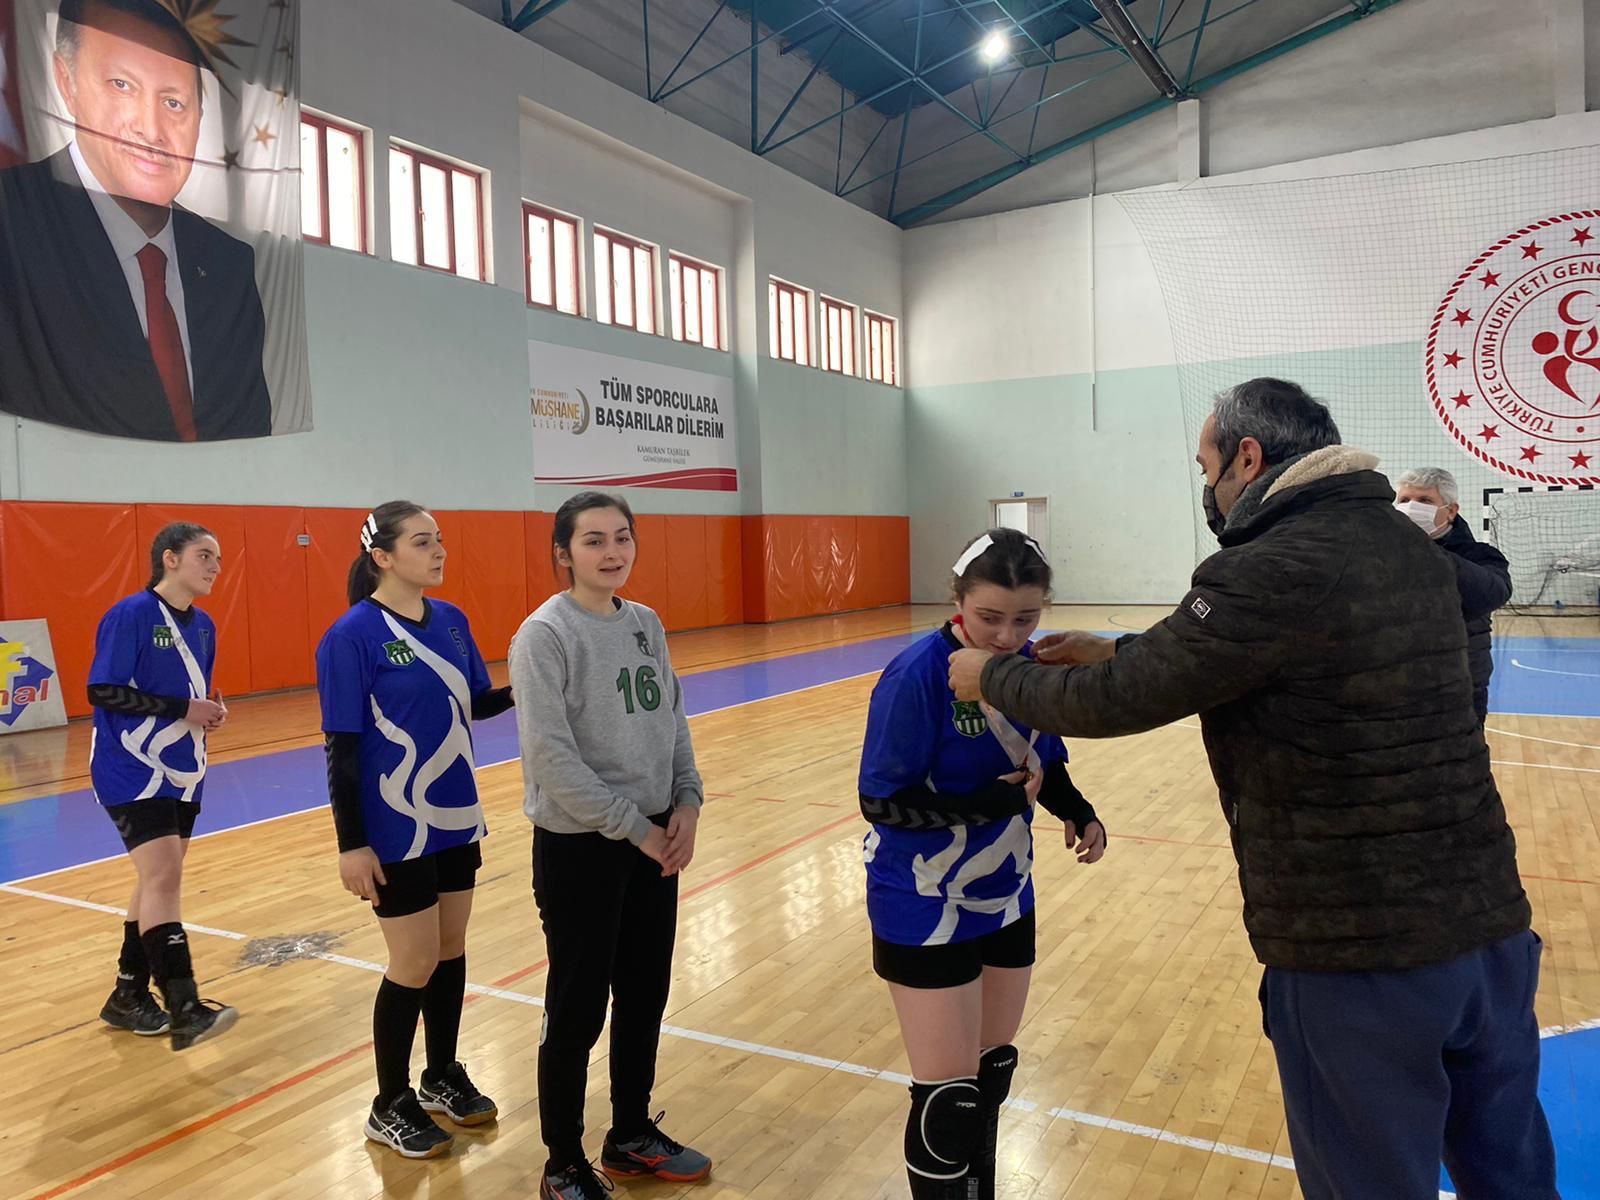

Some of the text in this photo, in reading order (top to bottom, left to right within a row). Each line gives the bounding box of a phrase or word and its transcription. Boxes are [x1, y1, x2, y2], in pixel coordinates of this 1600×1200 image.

[1481, 270, 1548, 380] CUMHURİYETİ
[600, 376, 719, 415] TÜM SPORCULARA
[1489, 383, 1554, 433] TÜRKİYE
[595, 406, 724, 440] BAŞARILAR DİLERİM
[616, 665, 661, 714] 16
